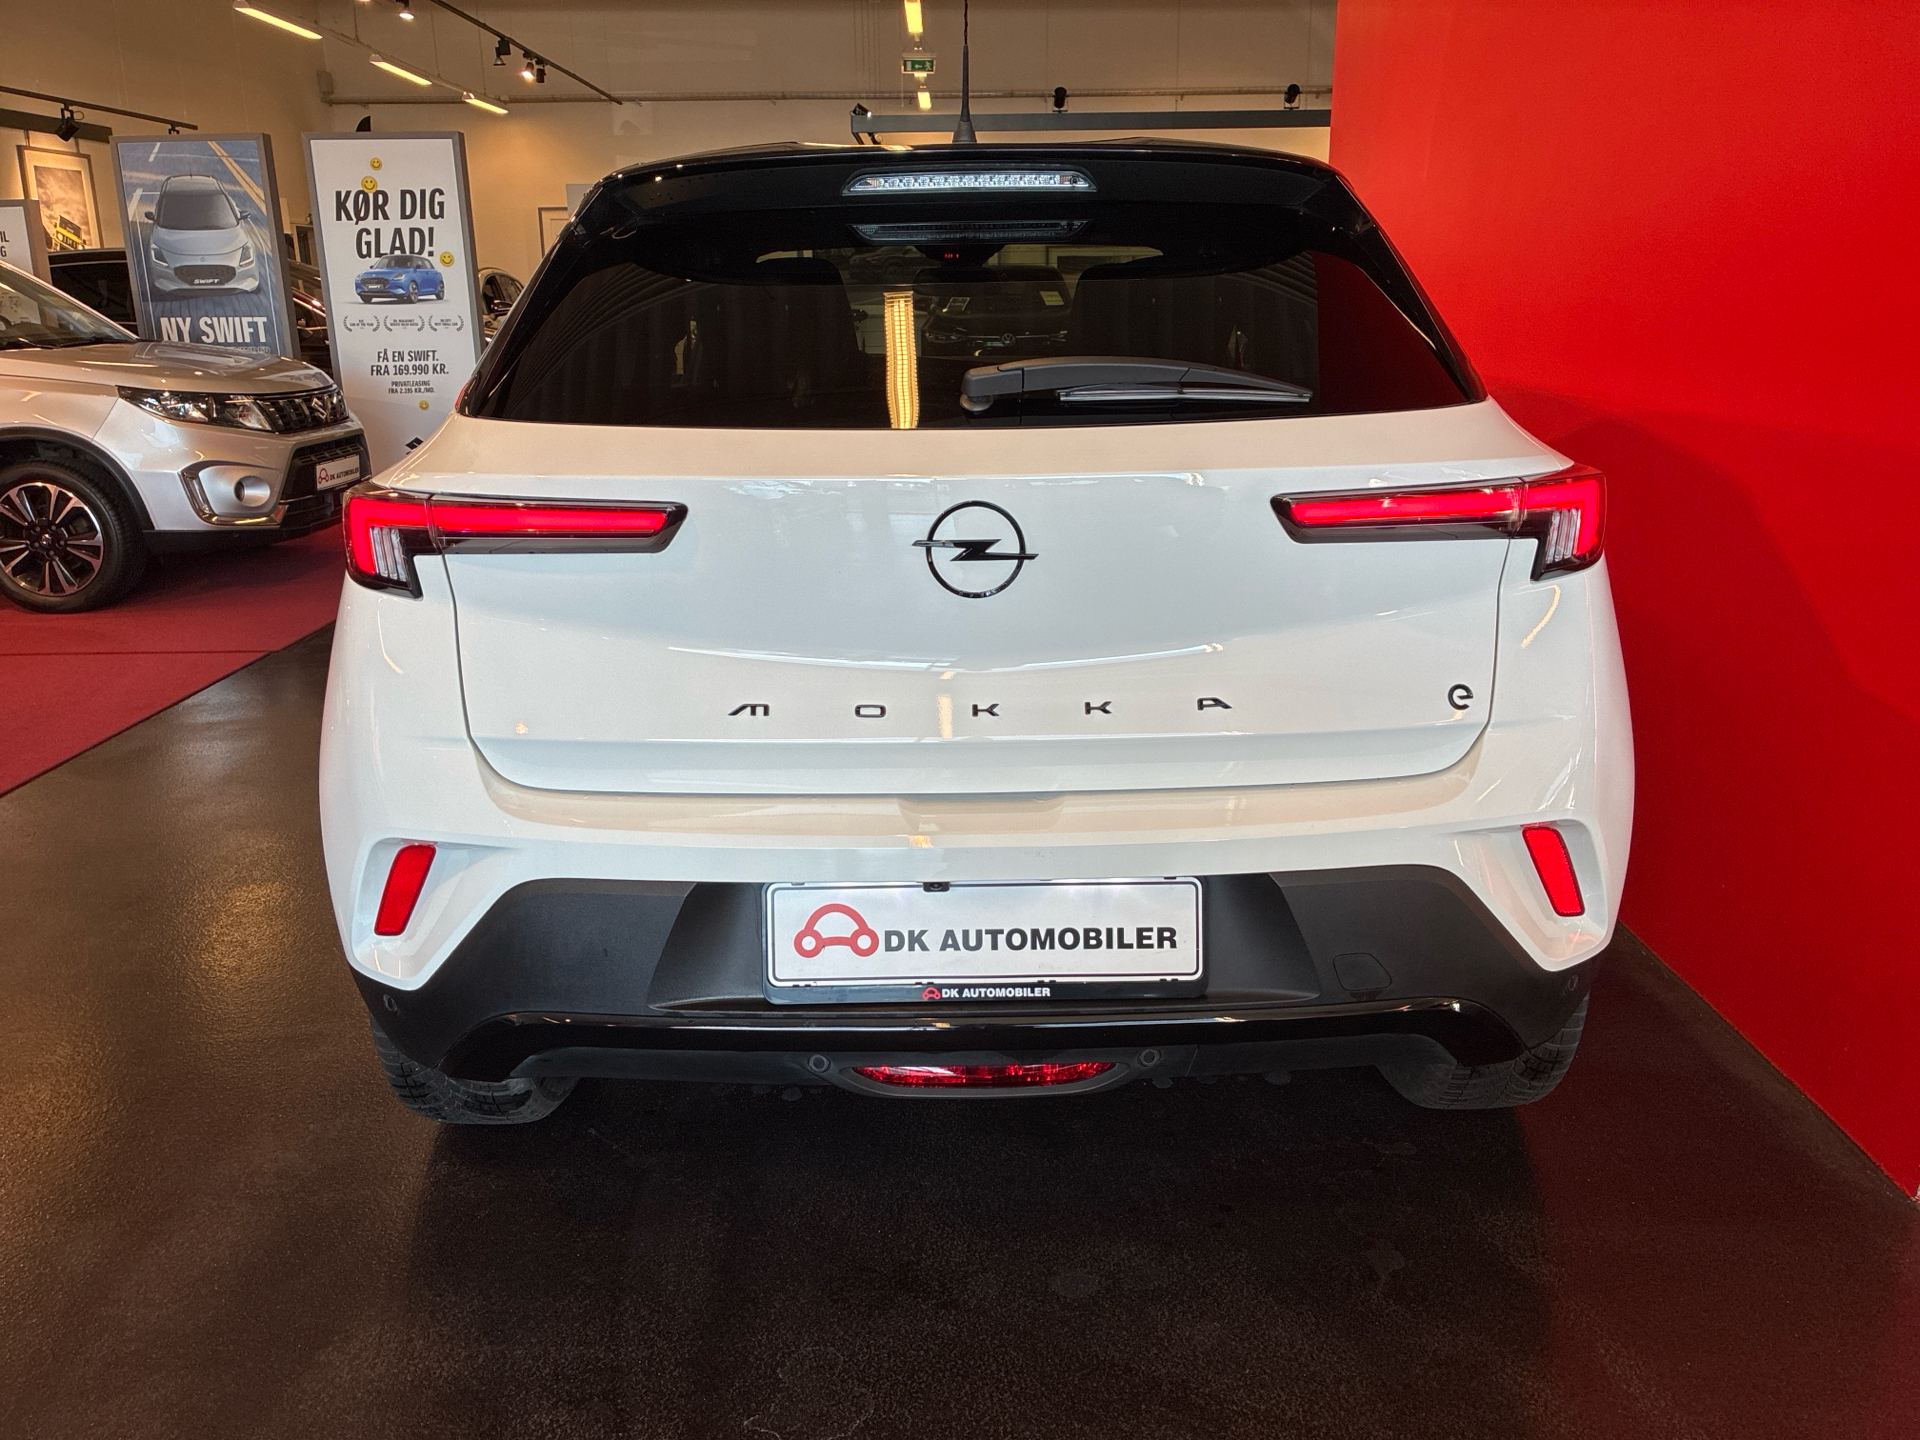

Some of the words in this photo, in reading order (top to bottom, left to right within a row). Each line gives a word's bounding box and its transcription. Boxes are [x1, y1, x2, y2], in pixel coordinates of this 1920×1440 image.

[335, 189, 390, 225] KØR
[400, 188, 445, 220] DIG
[355, 227, 434, 259] GLAD!
[160, 317, 191, 343] NY
[199, 316, 268, 343] SWIFT
[377, 348, 389, 363] FÅ
[392, 350, 405, 362] EN
[407, 349, 439, 362] SWIFT.
[370, 364, 390, 377] FRA
[392, 363, 430, 376] 169.990
[432, 363, 449, 375] KR.
[728, 697, 1232, 717] MOKKA
[884, 929, 930, 952] DK
[939, 927, 1178, 951] AUTOMOBILER
[941, 988, 959, 998] DK
[962, 987, 1051, 998] AUTOMOBILER
